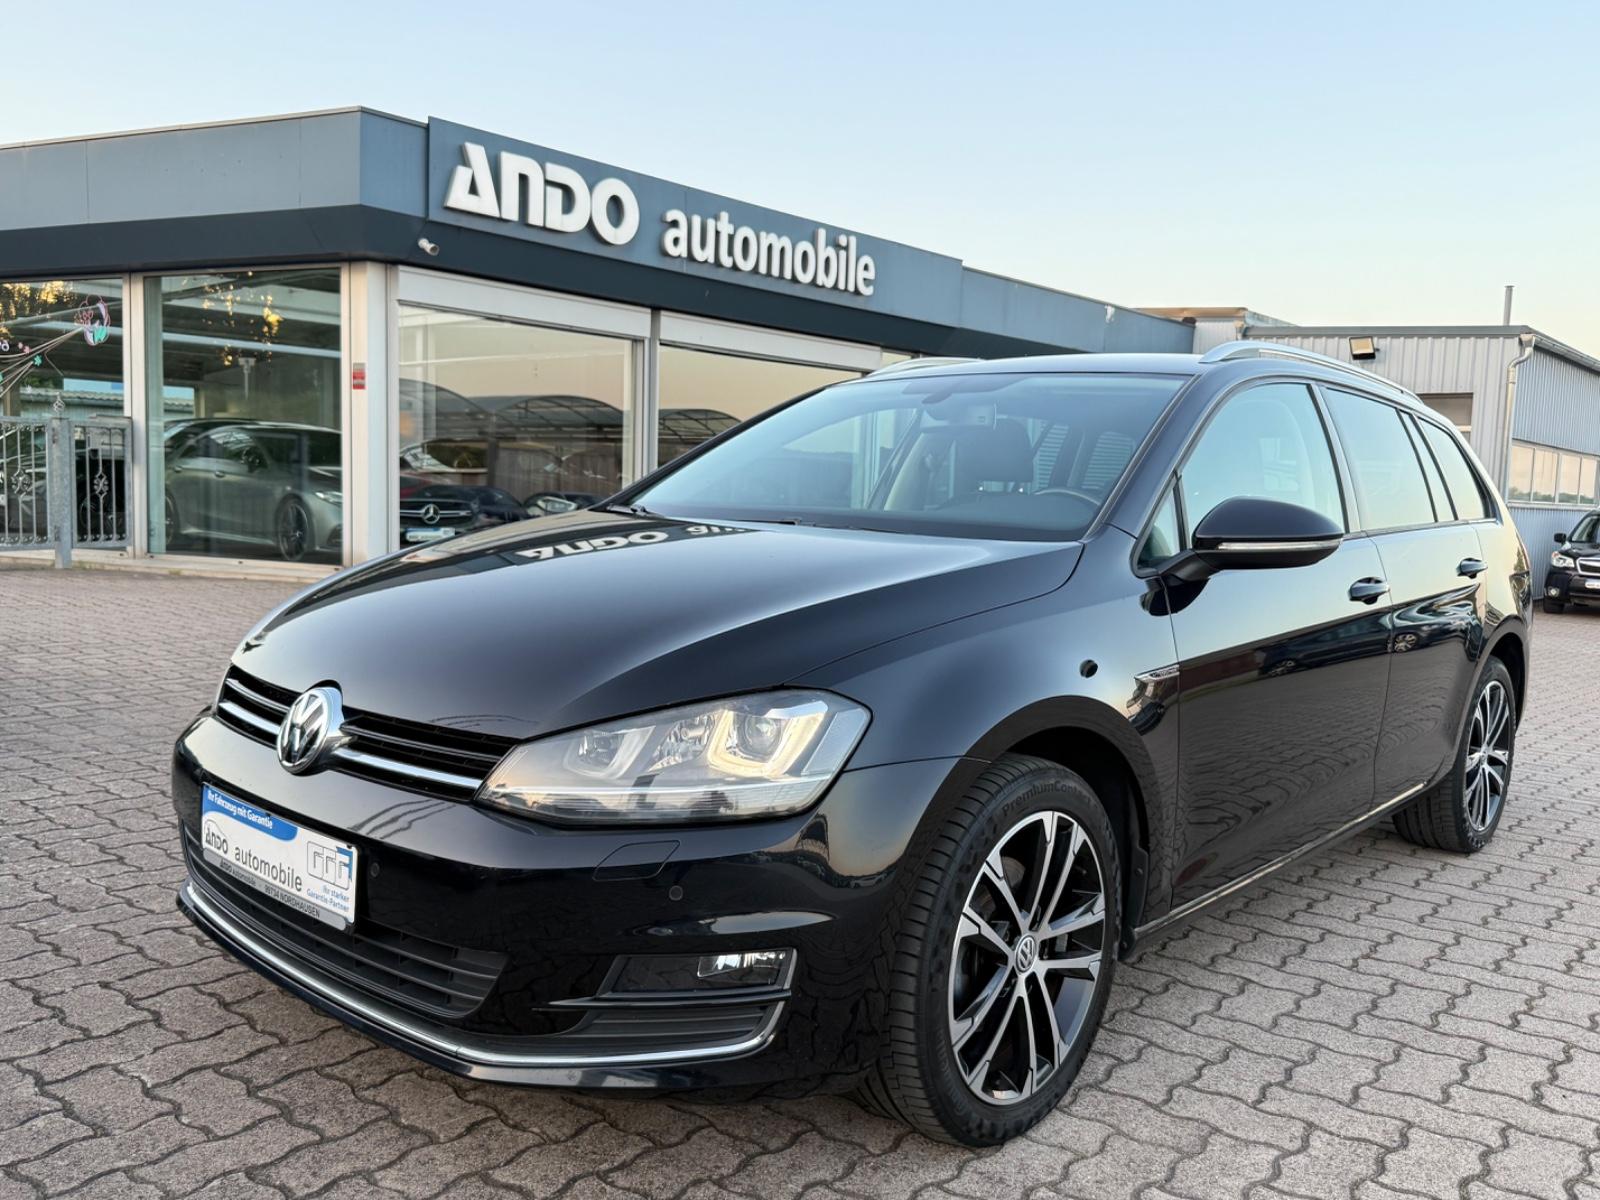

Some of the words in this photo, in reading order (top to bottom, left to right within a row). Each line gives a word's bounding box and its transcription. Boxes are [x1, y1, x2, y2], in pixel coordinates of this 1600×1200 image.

[444, 141, 640, 246] ANDO
[662, 209, 876, 297] automobile
[247, 809, 273, 830] Garantie
[234, 846, 302, 892] automobile
